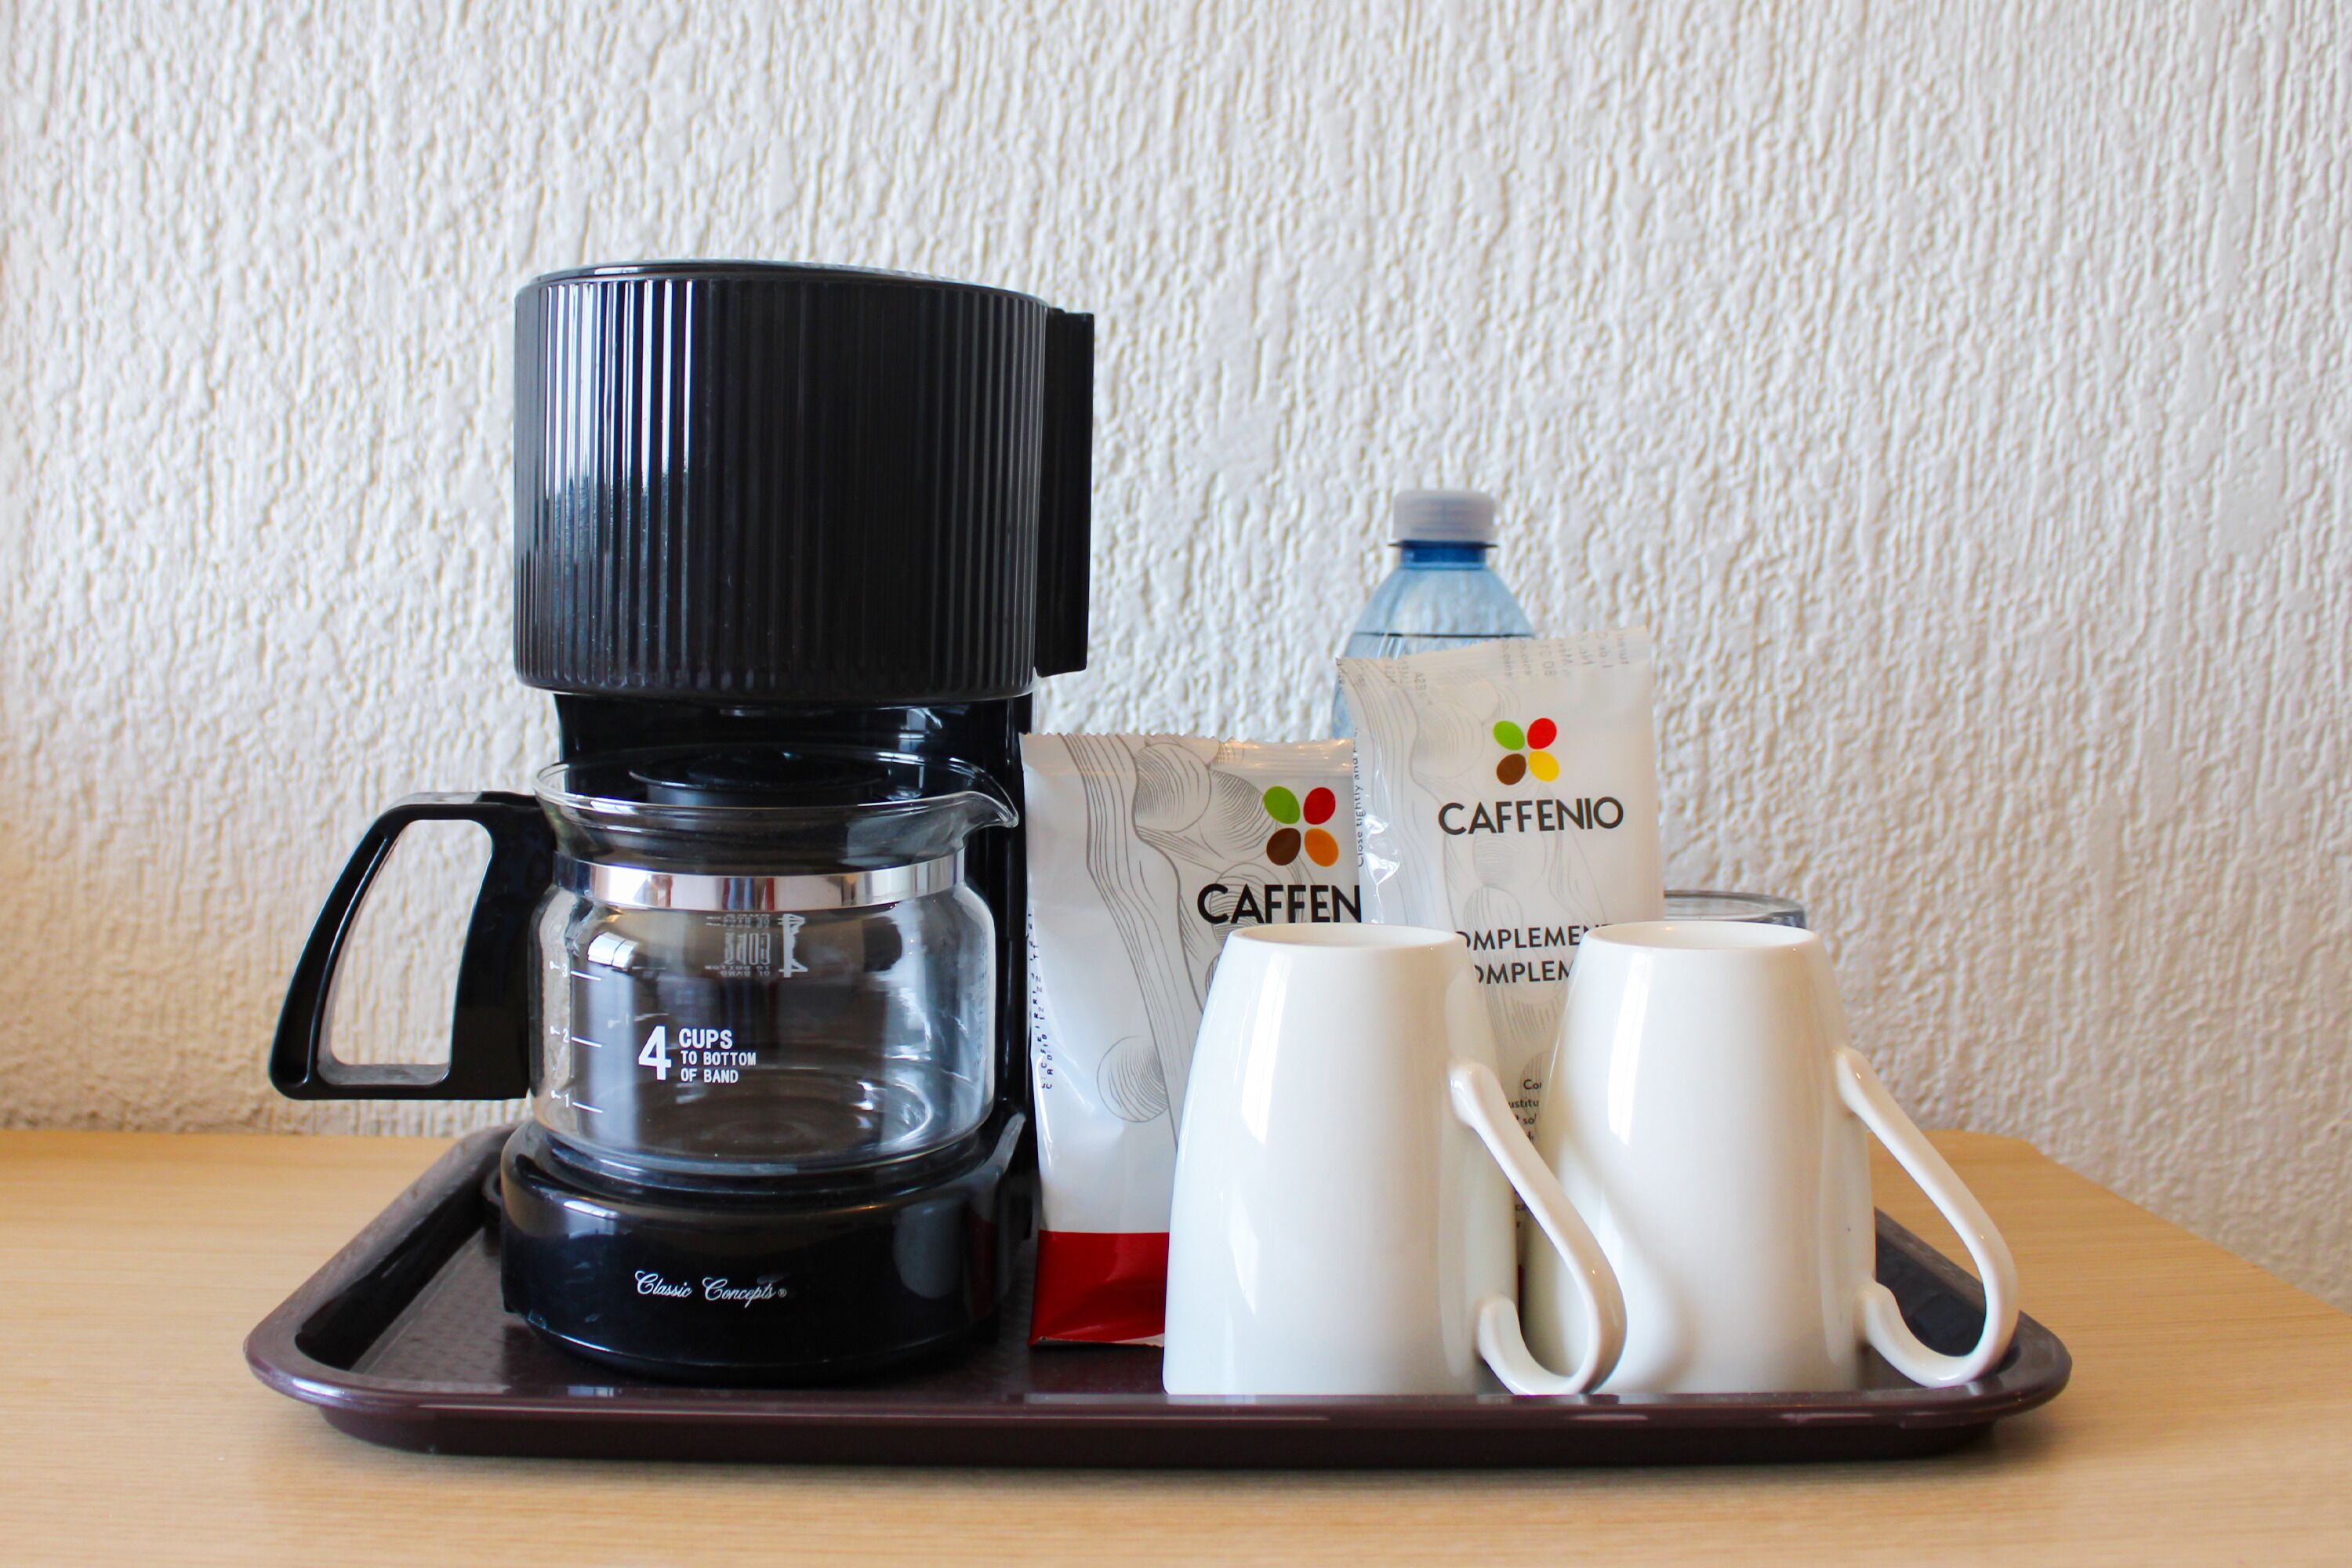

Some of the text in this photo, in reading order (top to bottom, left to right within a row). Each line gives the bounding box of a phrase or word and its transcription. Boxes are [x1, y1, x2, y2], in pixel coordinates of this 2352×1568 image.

[1438, 796, 1624, 835] CAFFENIO
[1197, 883, 1362, 924] CAFFEN
[1456, 924, 1612, 950] MPLEME
[562, 964, 568, 978] 3
[562, 1028, 569, 1043] 2
[679, 1028, 733, 1050] CUPS
[638, 1025, 672, 1080] 4
[681, 1051, 757, 1066] TO BOTTOM
[681, 1068, 739, 1083] OF BAND
[564, 1094, 569, 1107] 1
[635, 1270, 692, 1298] Classic
